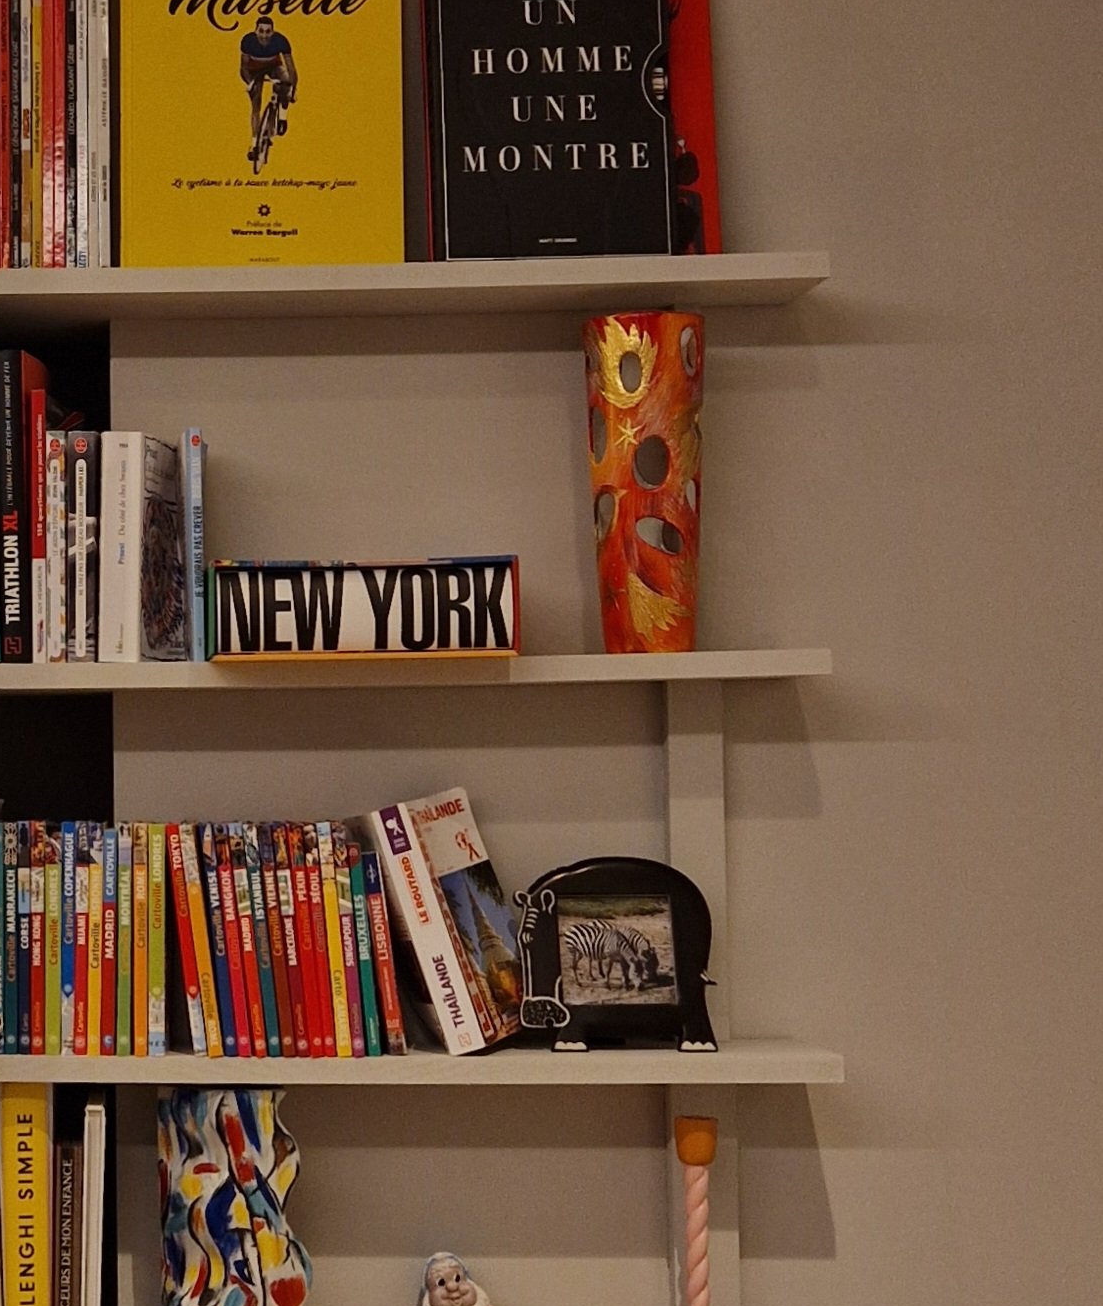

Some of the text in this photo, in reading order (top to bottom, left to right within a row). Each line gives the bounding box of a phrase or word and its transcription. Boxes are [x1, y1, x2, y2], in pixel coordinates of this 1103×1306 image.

[471, 45, 633, 75] HOMME
[511, 95, 597, 122] UNE
[462, 142, 650, 172] MONTRE
[186, 178, 222, 190] cyclisme
[233, 178, 243, 186] la
[331, 178, 357, 190] jaune
[231, 228, 263, 236] Warren
[4, 409, 11, 419] UN
[193, 506, 203, 534] CREVER
[193, 536, 203, 550] PAS
[2, 510, 20, 625] TRIATHLON XL
[193, 552, 204, 589] VOUDRAIS
[218, 567, 510, 653] NEW YORK
[63, 832, 73, 897] COPENHAGUE
[170, 834, 181, 870] TOKYO
[6, 869, 15, 933] MARRAKECH
[104, 838, 114, 959] MADRID CARTOVILLE
[119, 870, 129, 925] MONTRÉAL
[136, 870, 145, 900] ROME
[152, 834, 162, 930] Cartoville LONDRES
[221, 870, 235, 921] BANGKOK
[251, 870, 265, 920] ISTANBUL
[264, 870, 277, 908] VIENNE
[294, 870, 306, 902] PÉKIN
[309, 870, 321, 903] SÉOUL
[401, 856, 429, 924] LE ROUTARD
[20, 917, 29, 949] CORSE
[49, 869, 58, 965] Cartoville LONDRES
[77, 915, 86, 946] MIAMI
[208, 870, 225, 956] Cartoville VENISE
[241, 917, 253, 952] MADRID
[354, 894, 370, 961] BRUXELLES
[371, 896, 389, 961] LISBONNE
[32, 915, 41, 966] HONG KONG
[90, 923, 100, 969] Cartoville
[284, 917, 297, 966] BARCELONE
[341, 915, 355, 967] SINGAPOUR
[432, 953, 464, 1028] THAÏLANDE
[17, 1114, 34, 1200] SIMPLE
[62, 1159, 73, 1216] ENFANCE
[61, 1218, 72, 1247] MON
[61, 1248, 71, 1266] DE
